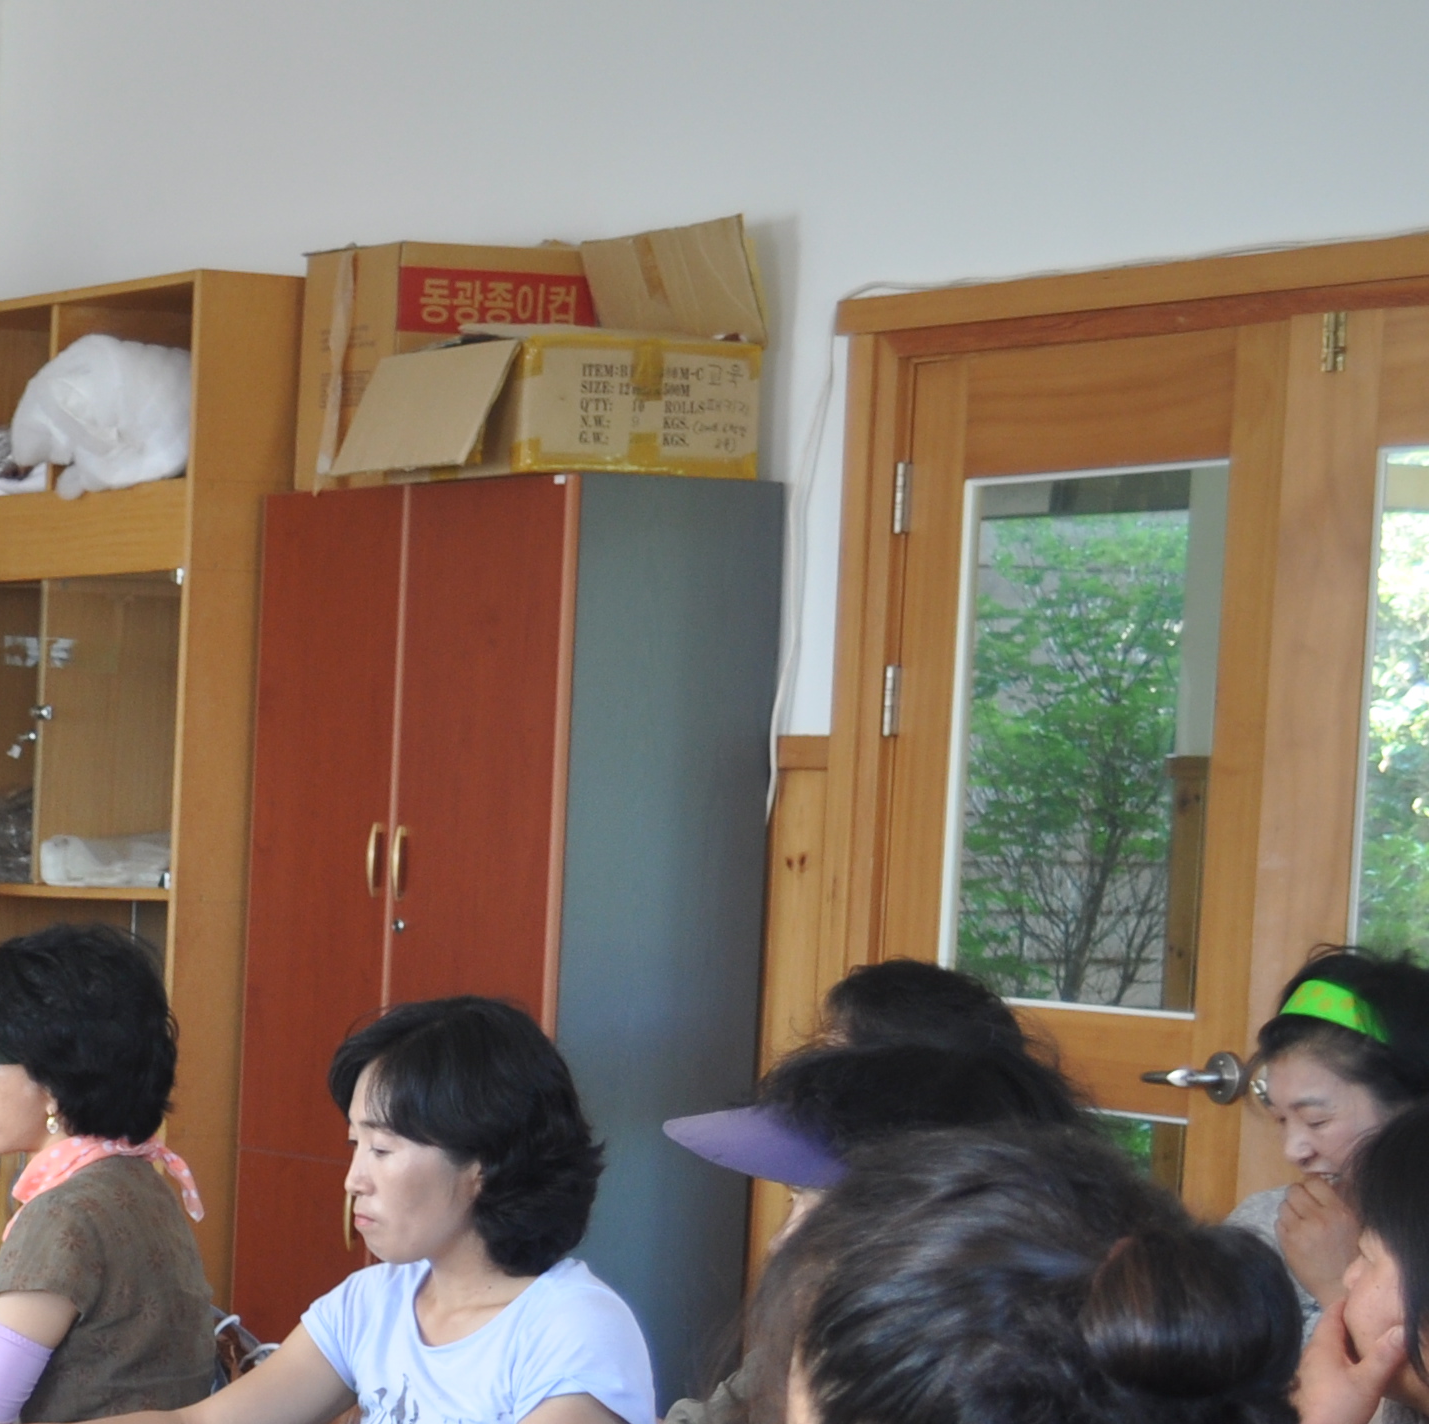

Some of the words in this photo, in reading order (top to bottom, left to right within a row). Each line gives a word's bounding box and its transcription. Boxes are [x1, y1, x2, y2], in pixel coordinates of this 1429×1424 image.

[420, 278, 578, 325] 동광종이컵
[580, 381, 614, 394] SIZE:
[664, 400, 705, 414] ROLLS
